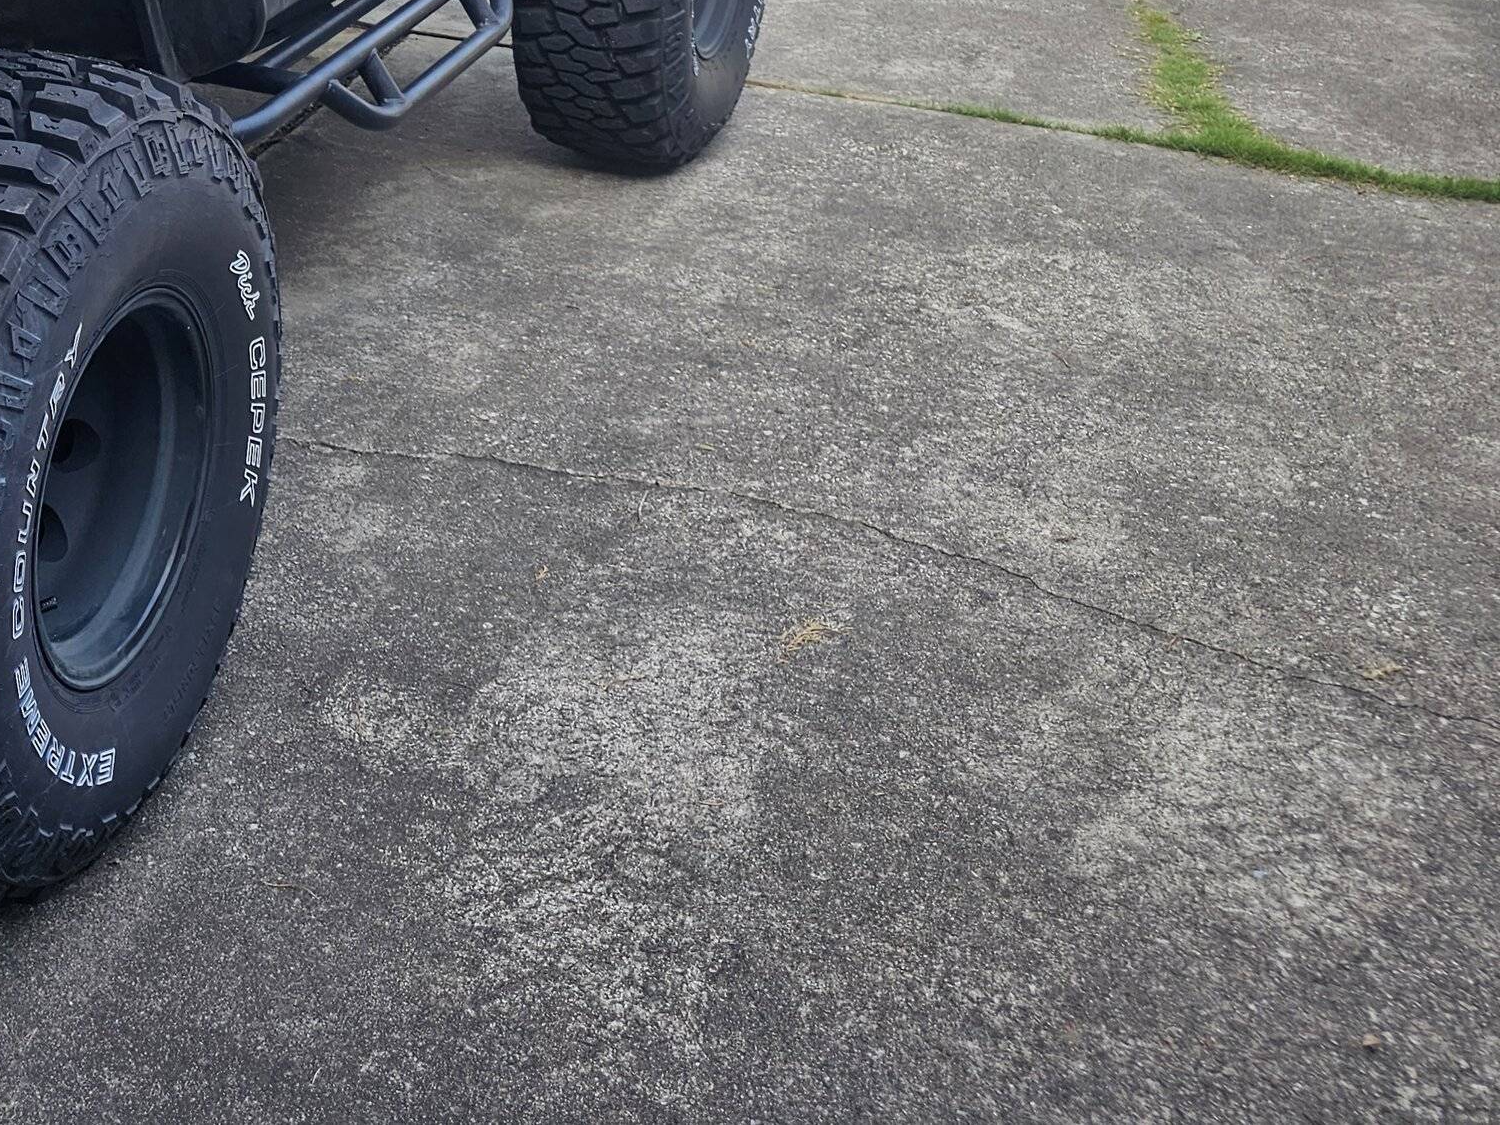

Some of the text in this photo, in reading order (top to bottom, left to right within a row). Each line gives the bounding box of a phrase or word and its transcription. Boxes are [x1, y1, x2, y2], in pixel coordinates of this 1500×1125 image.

[11, 323, 116, 787] EXTREME COUNTRY
[228, 250, 267, 508] Dick CEPEK
